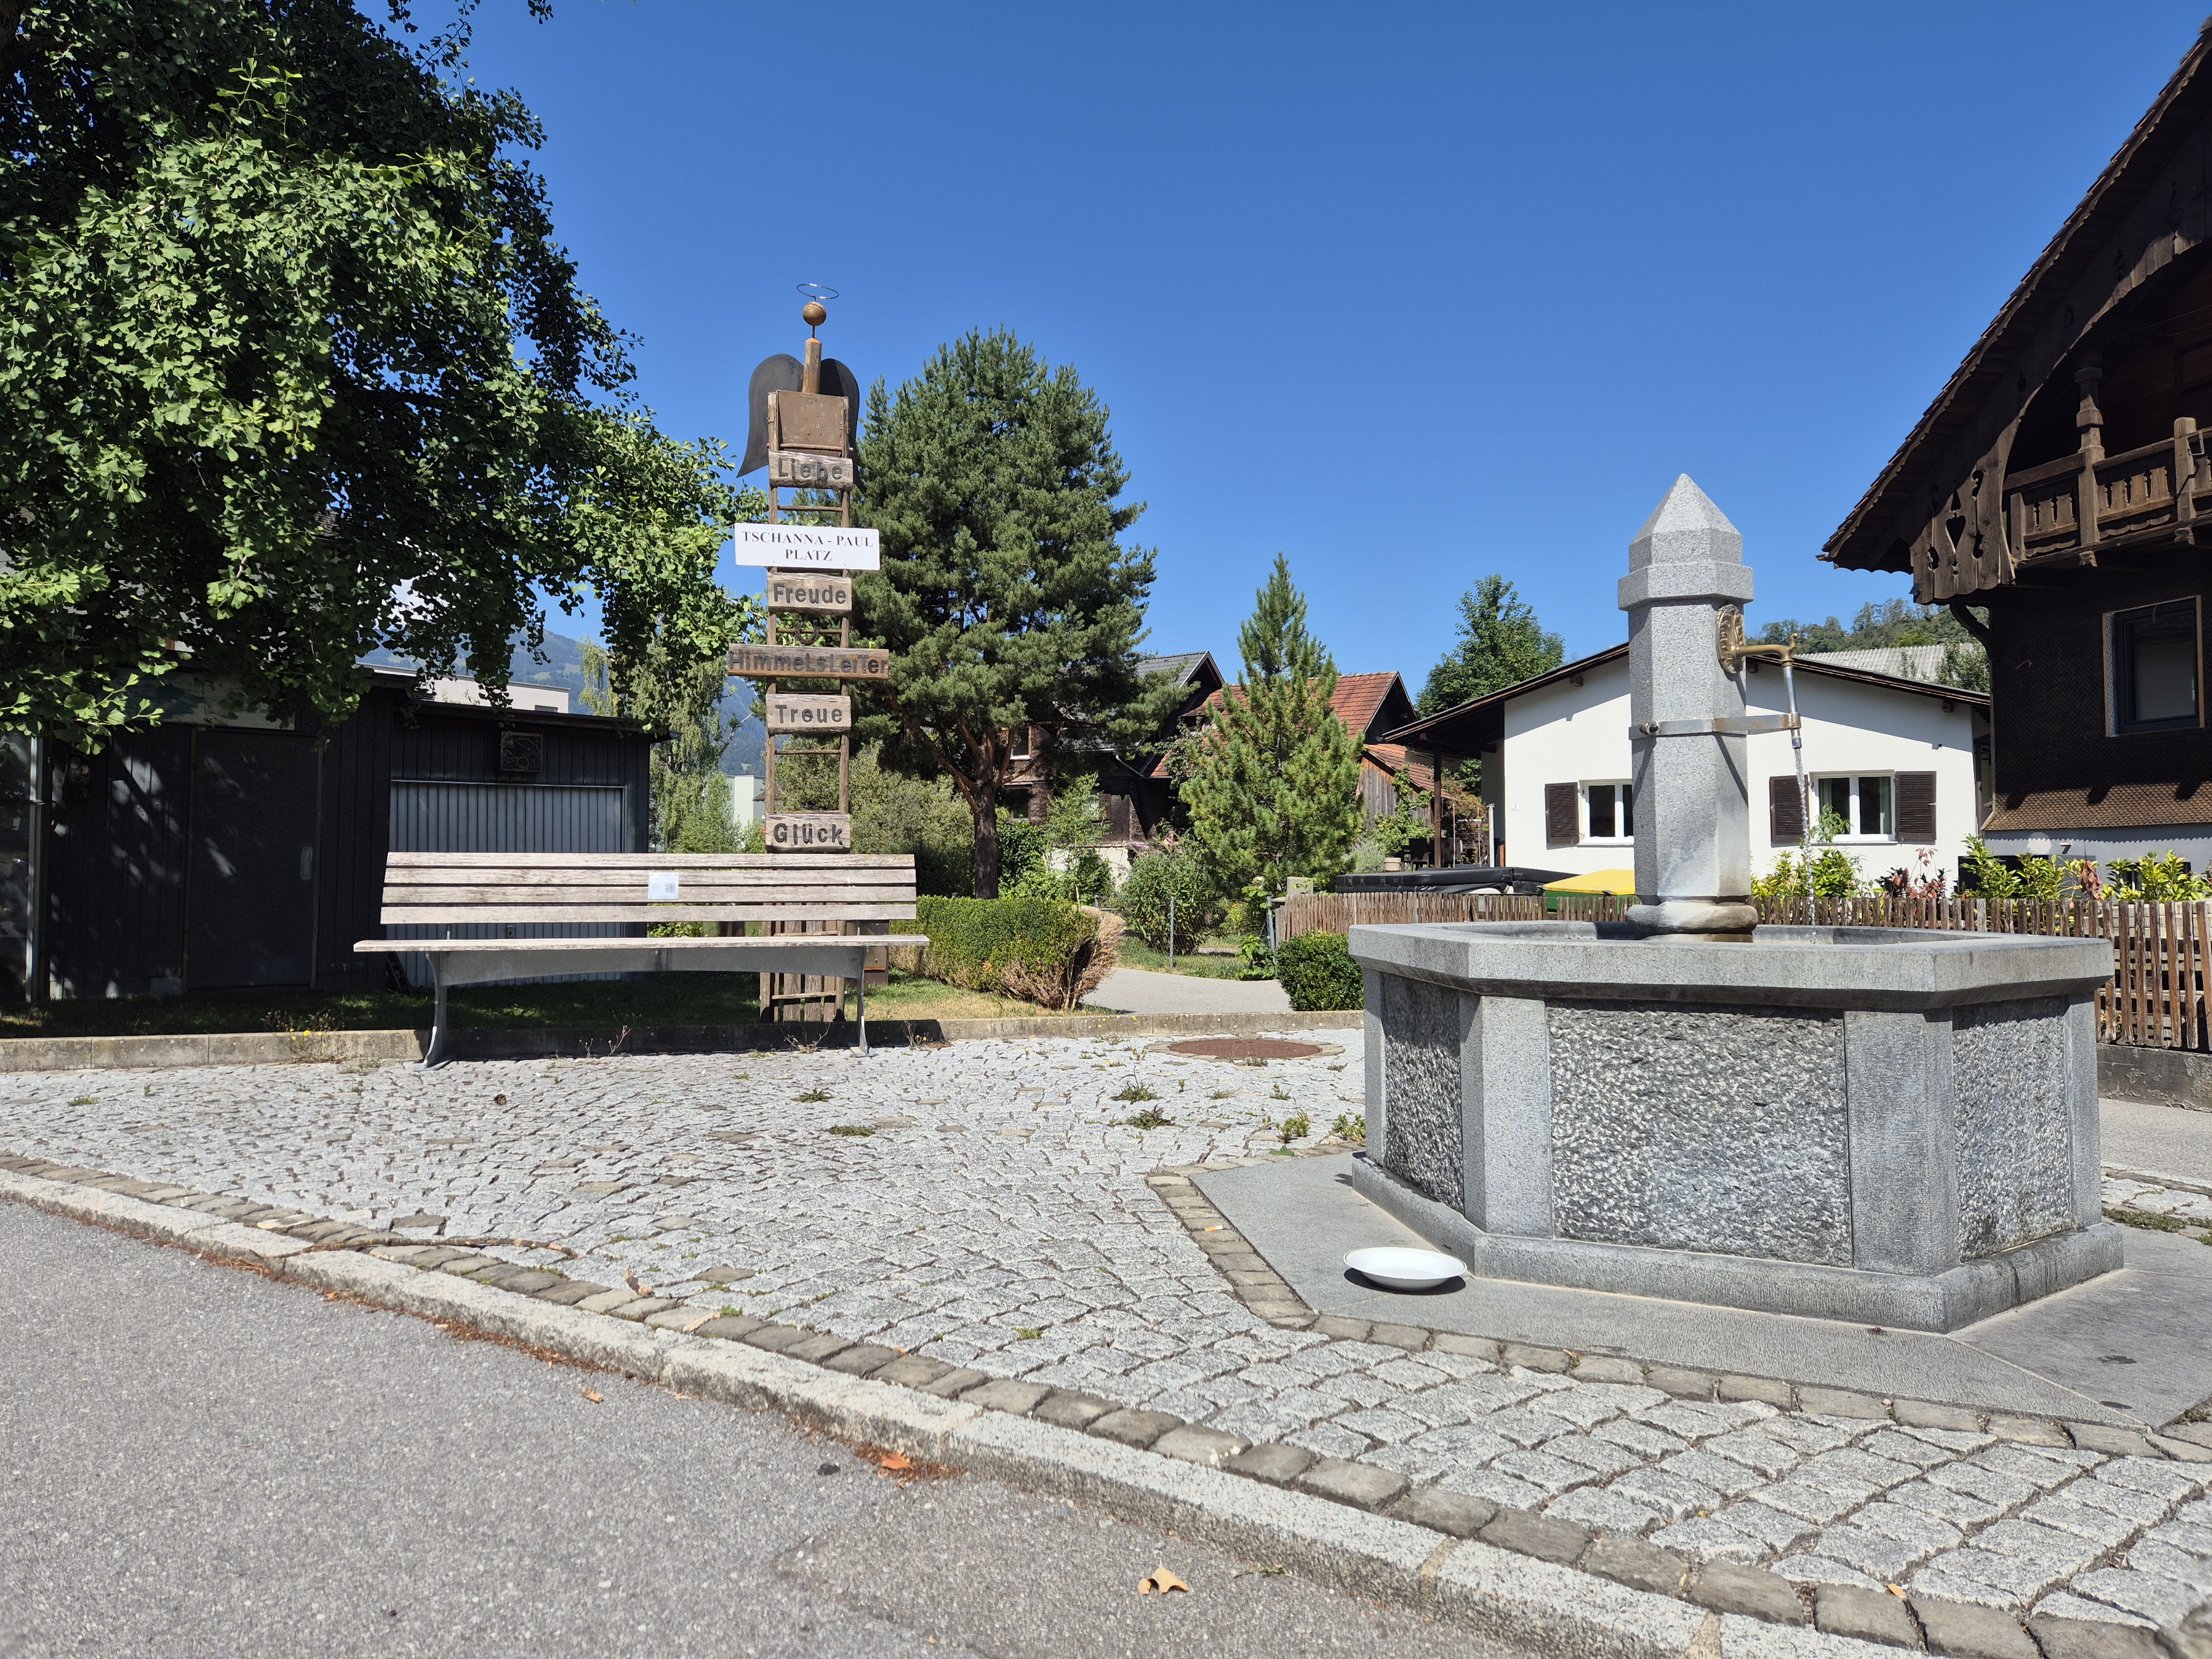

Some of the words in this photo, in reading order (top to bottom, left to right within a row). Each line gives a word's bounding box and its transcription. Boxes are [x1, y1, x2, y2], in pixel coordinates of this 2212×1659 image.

[778, 457, 843, 480] Liebe
[741, 531, 824, 545] TSCHANNA
[836, 535, 874, 547] PAUL
[785, 549, 832, 561] PLATZ
[774, 583, 847, 604] Freude
[775, 704, 843, 724] Treue
[774, 822, 844, 846] Glück
[2059, 842, 2072, 854] 7
